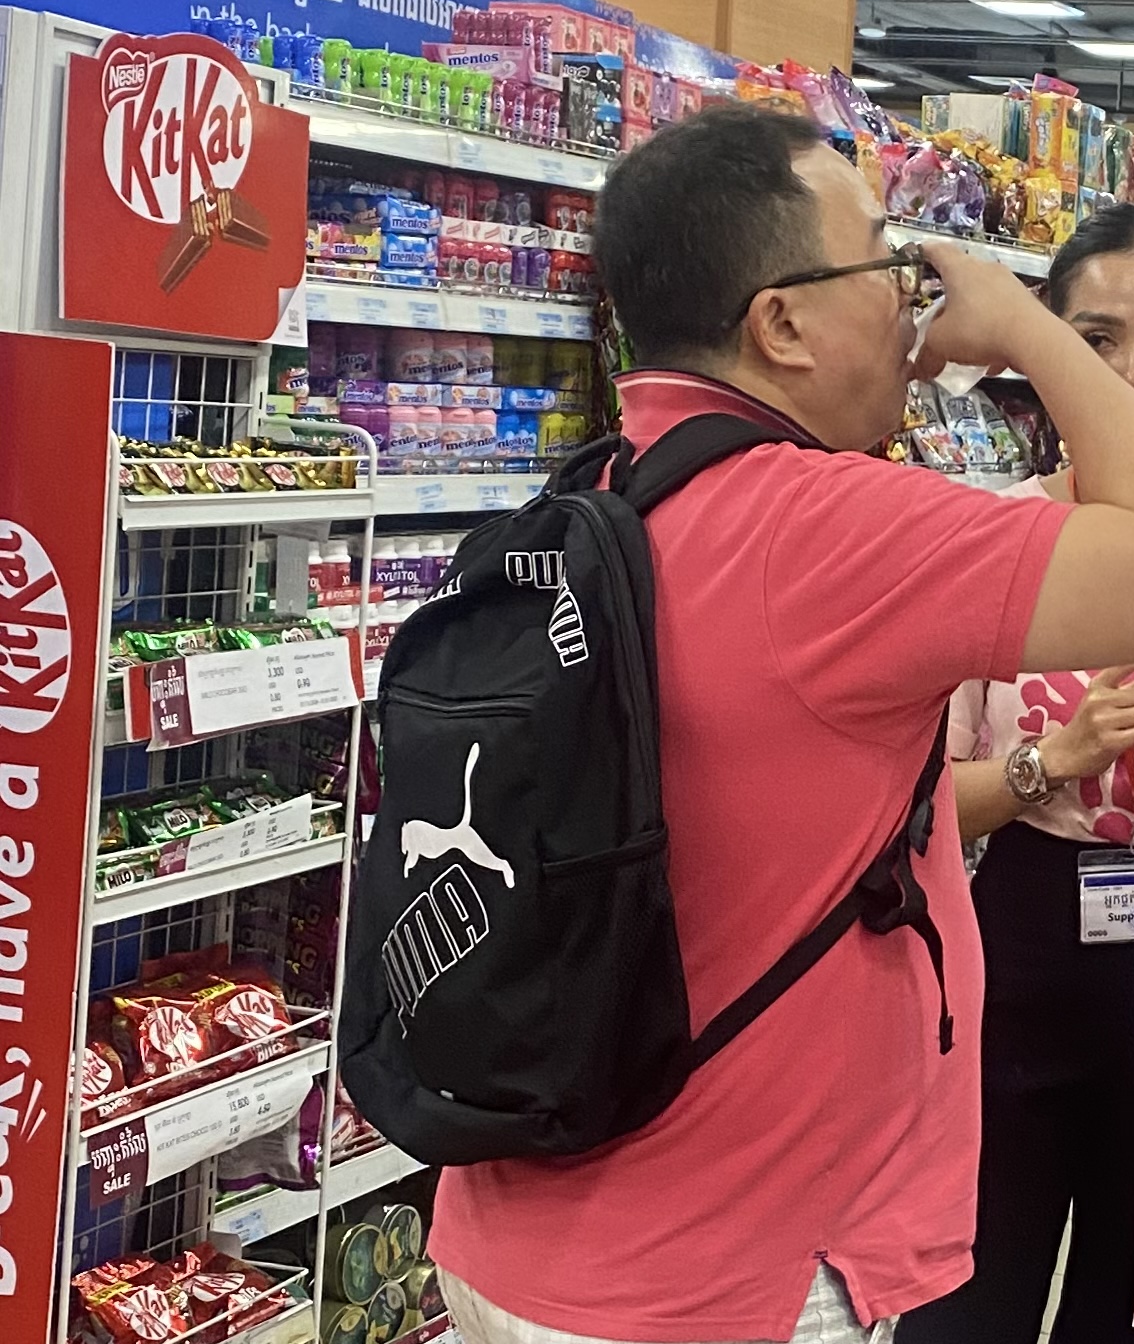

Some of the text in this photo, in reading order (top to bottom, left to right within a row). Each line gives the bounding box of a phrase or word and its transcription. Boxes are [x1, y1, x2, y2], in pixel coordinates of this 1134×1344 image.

[447, 49, 500, 68] mentos
[121, 57, 247, 220] KitKat
[391, 217, 429, 230] mentos
[388, 250, 425, 264] mentos
[160, 712, 179, 730] SALE
[166, 811, 188, 831] MILO
[107, 869, 132, 890] MILO
[381, 863, 490, 1040] UMA
[103, 1172, 131, 1196] SALE
